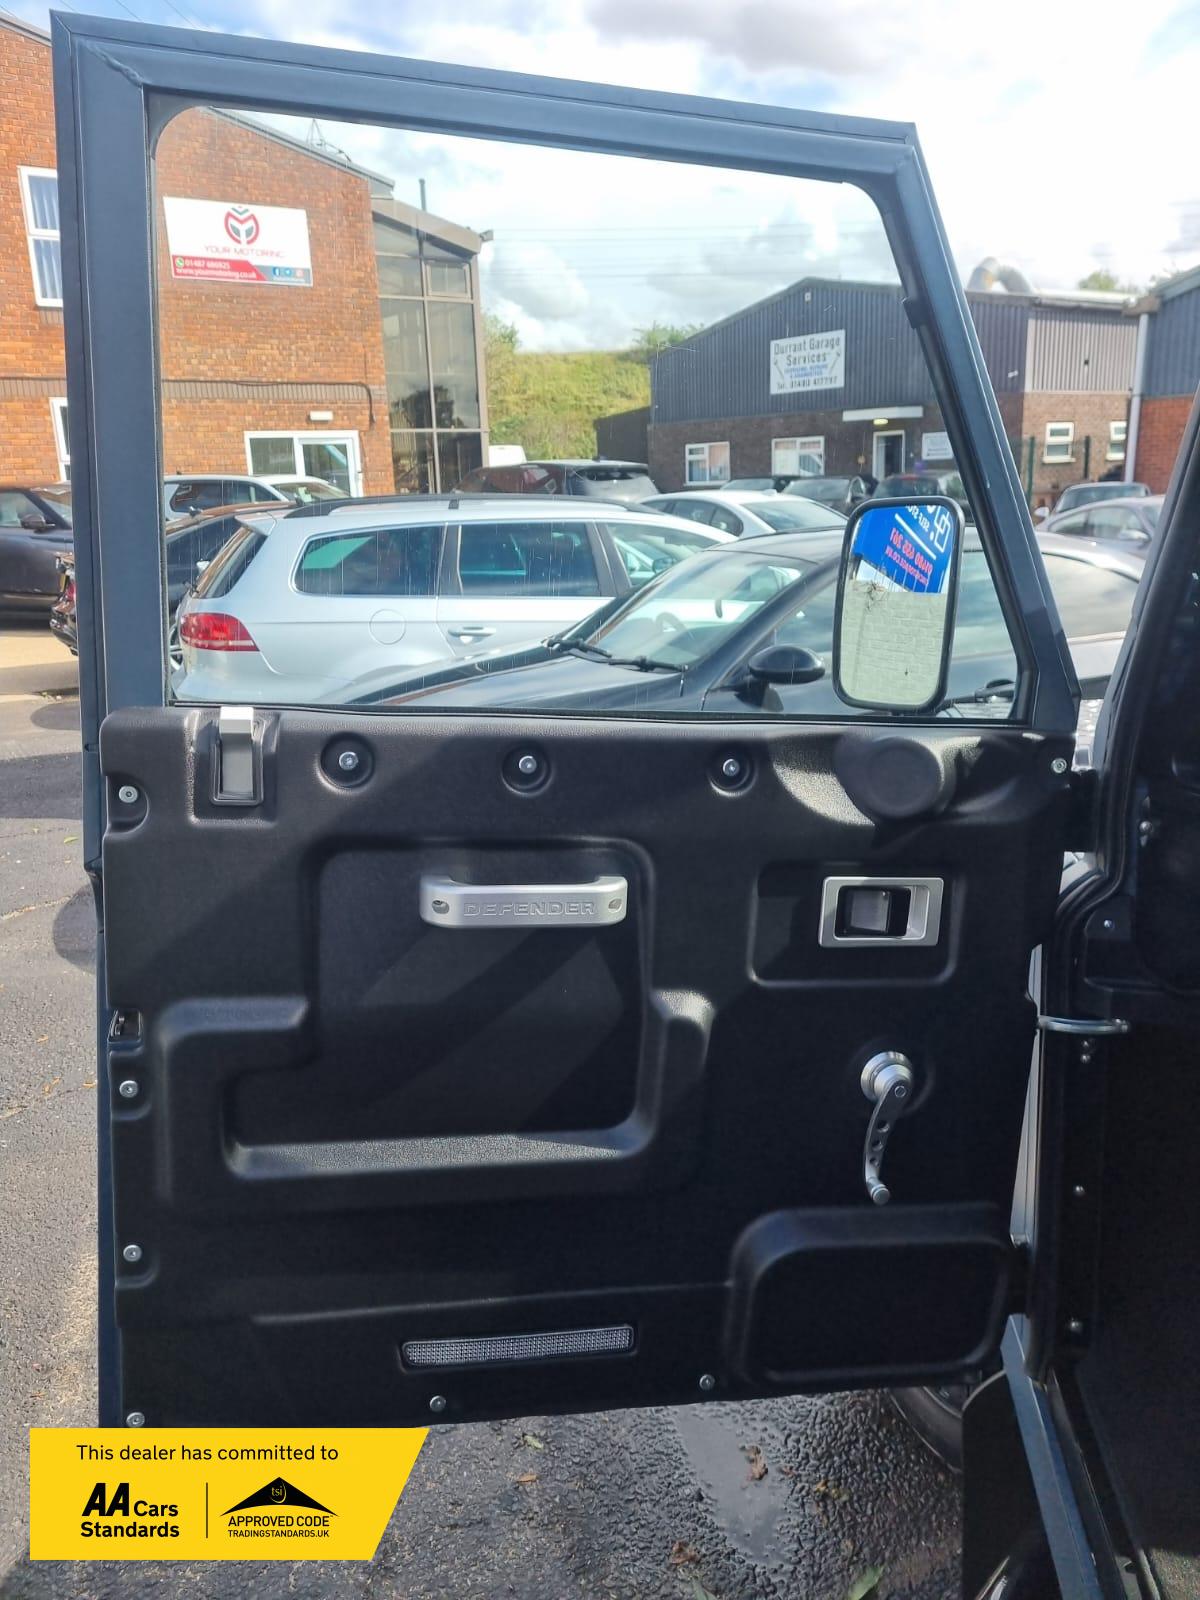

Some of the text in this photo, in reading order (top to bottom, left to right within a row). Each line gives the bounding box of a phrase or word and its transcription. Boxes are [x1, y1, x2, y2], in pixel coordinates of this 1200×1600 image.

[205, 245, 231, 255] YOUR
[774, 336, 841, 355] Durrant Garage
[786, 352, 827, 367] Services
[464, 902, 595, 917] DEFENDER
